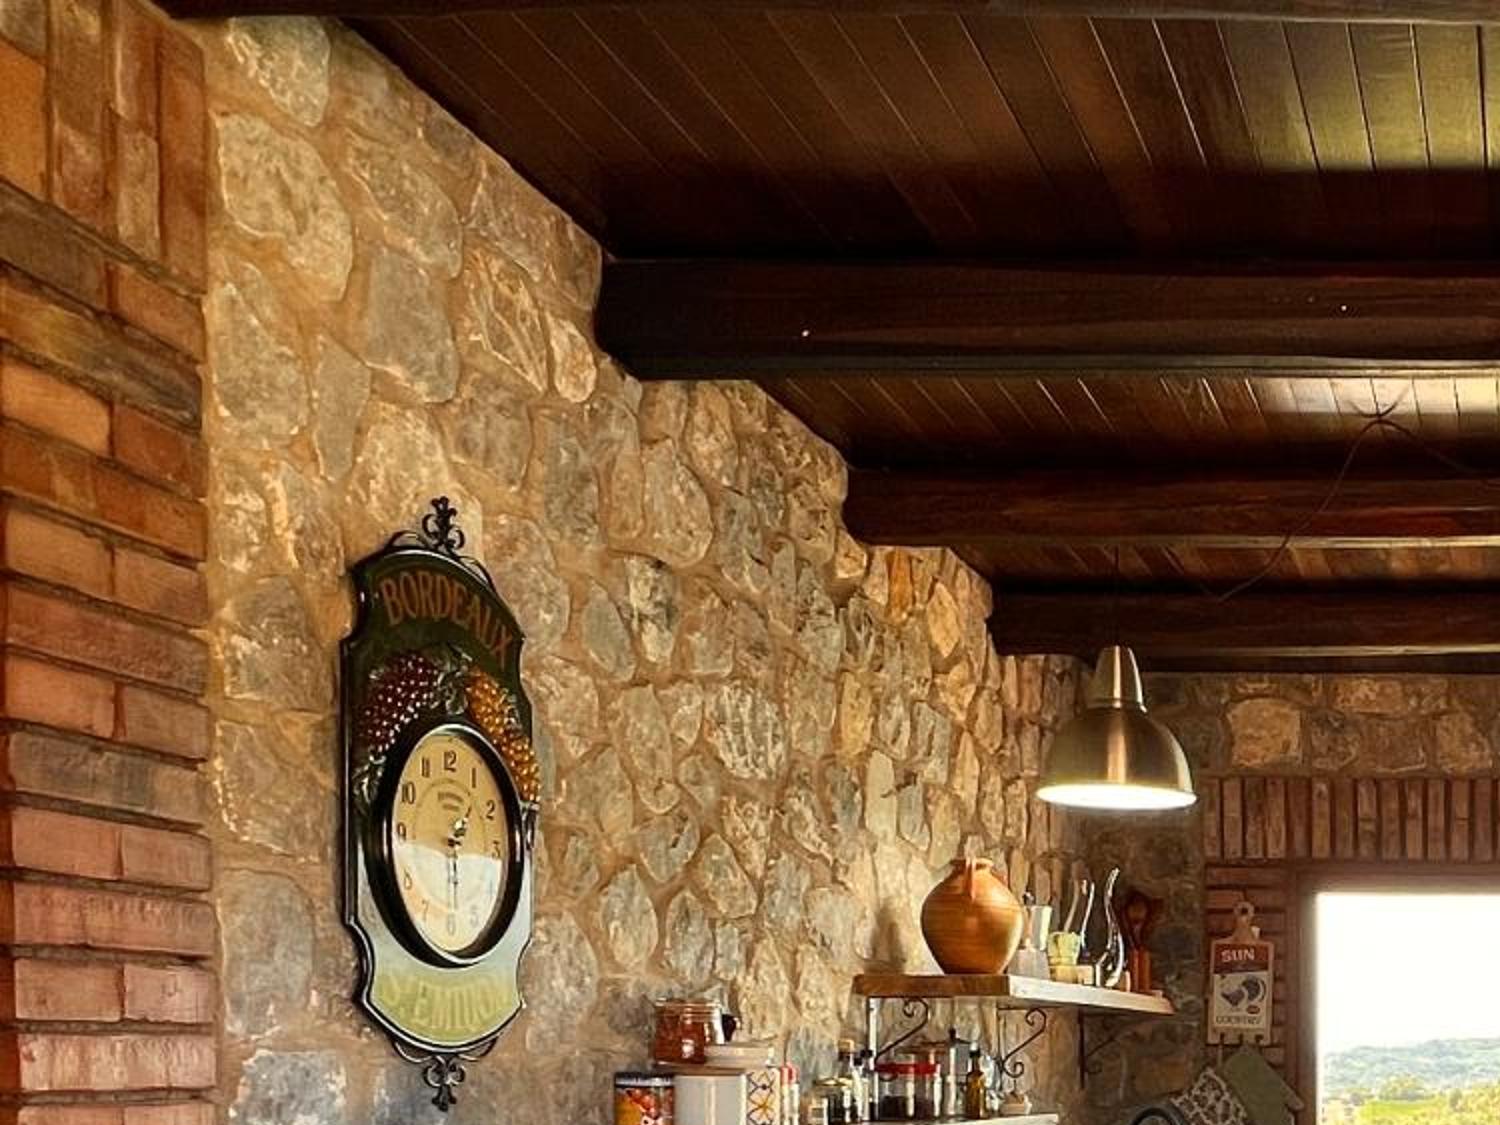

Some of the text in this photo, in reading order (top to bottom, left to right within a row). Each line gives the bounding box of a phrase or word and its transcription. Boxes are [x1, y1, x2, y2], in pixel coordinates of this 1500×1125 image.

[380, 571, 513, 662] BORDEAUX
[421, 756, 431, 778] 11
[443, 749, 457, 772] 12
[401, 780, 416, 804] 10
[485, 799, 496, 820] 2
[396, 821, 407, 841] 9
[1221, 947, 1256, 962] SUN
